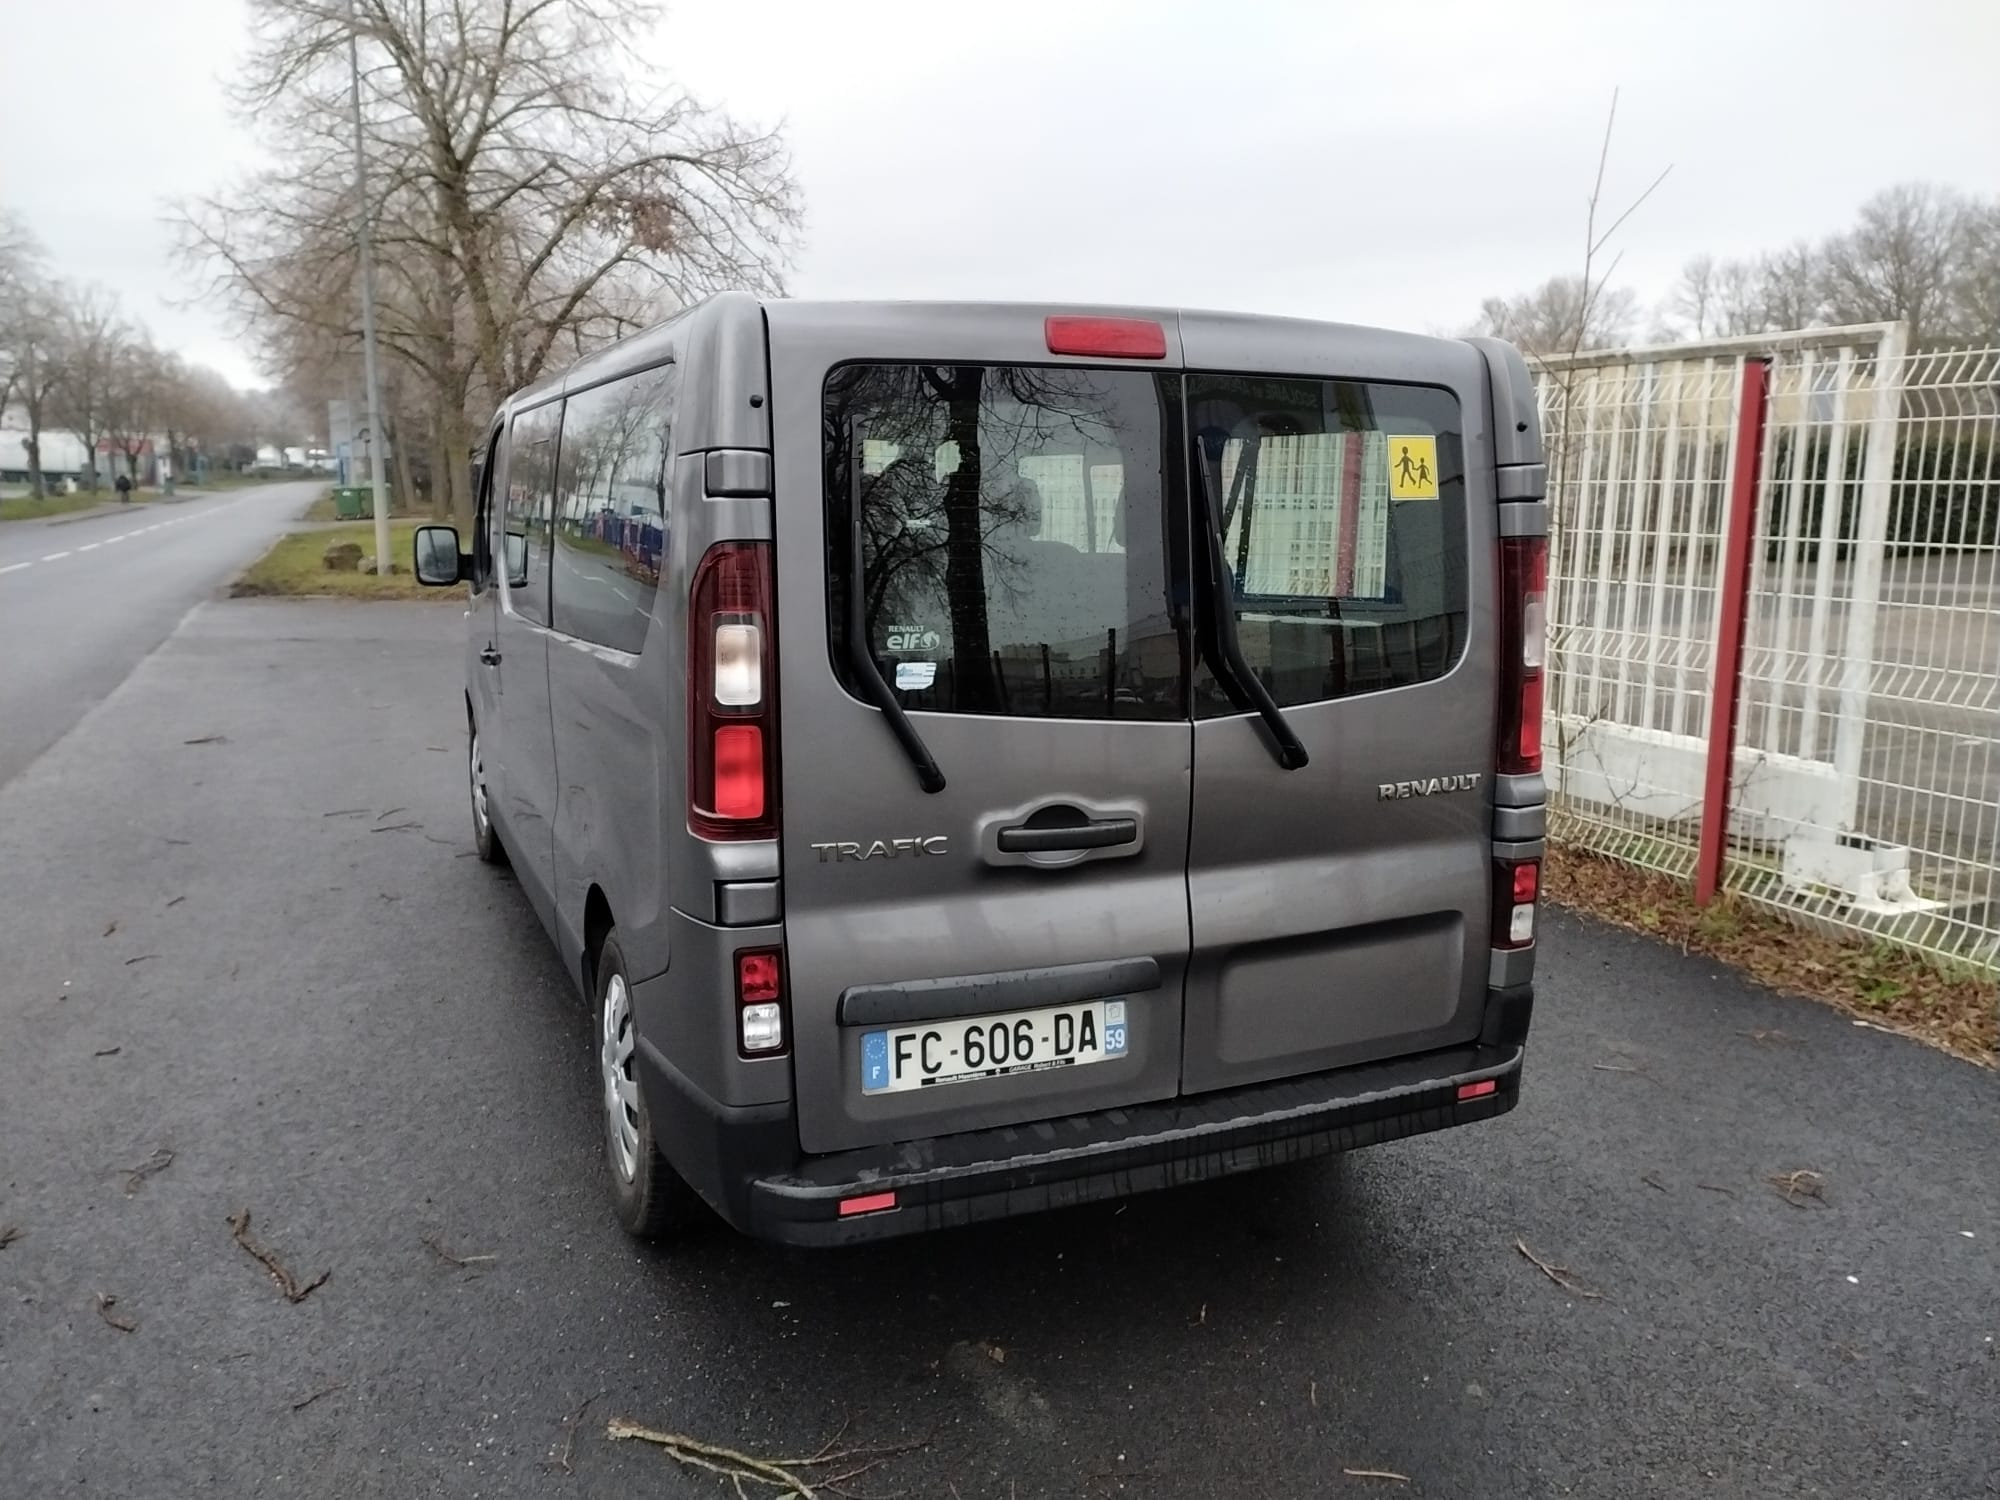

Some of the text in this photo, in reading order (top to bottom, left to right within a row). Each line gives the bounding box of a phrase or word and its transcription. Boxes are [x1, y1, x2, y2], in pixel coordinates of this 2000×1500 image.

[888, 625, 925, 633] RENAULT
[886, 633, 921, 649] elf
[1378, 772, 1481, 800] RENAULT
[810, 836, 948, 862] TRAFIC
[894, 1009, 1098, 1080] FC-606-DA
[1105, 1028, 1125, 1050] 59
[871, 1066, 881, 1080] F
